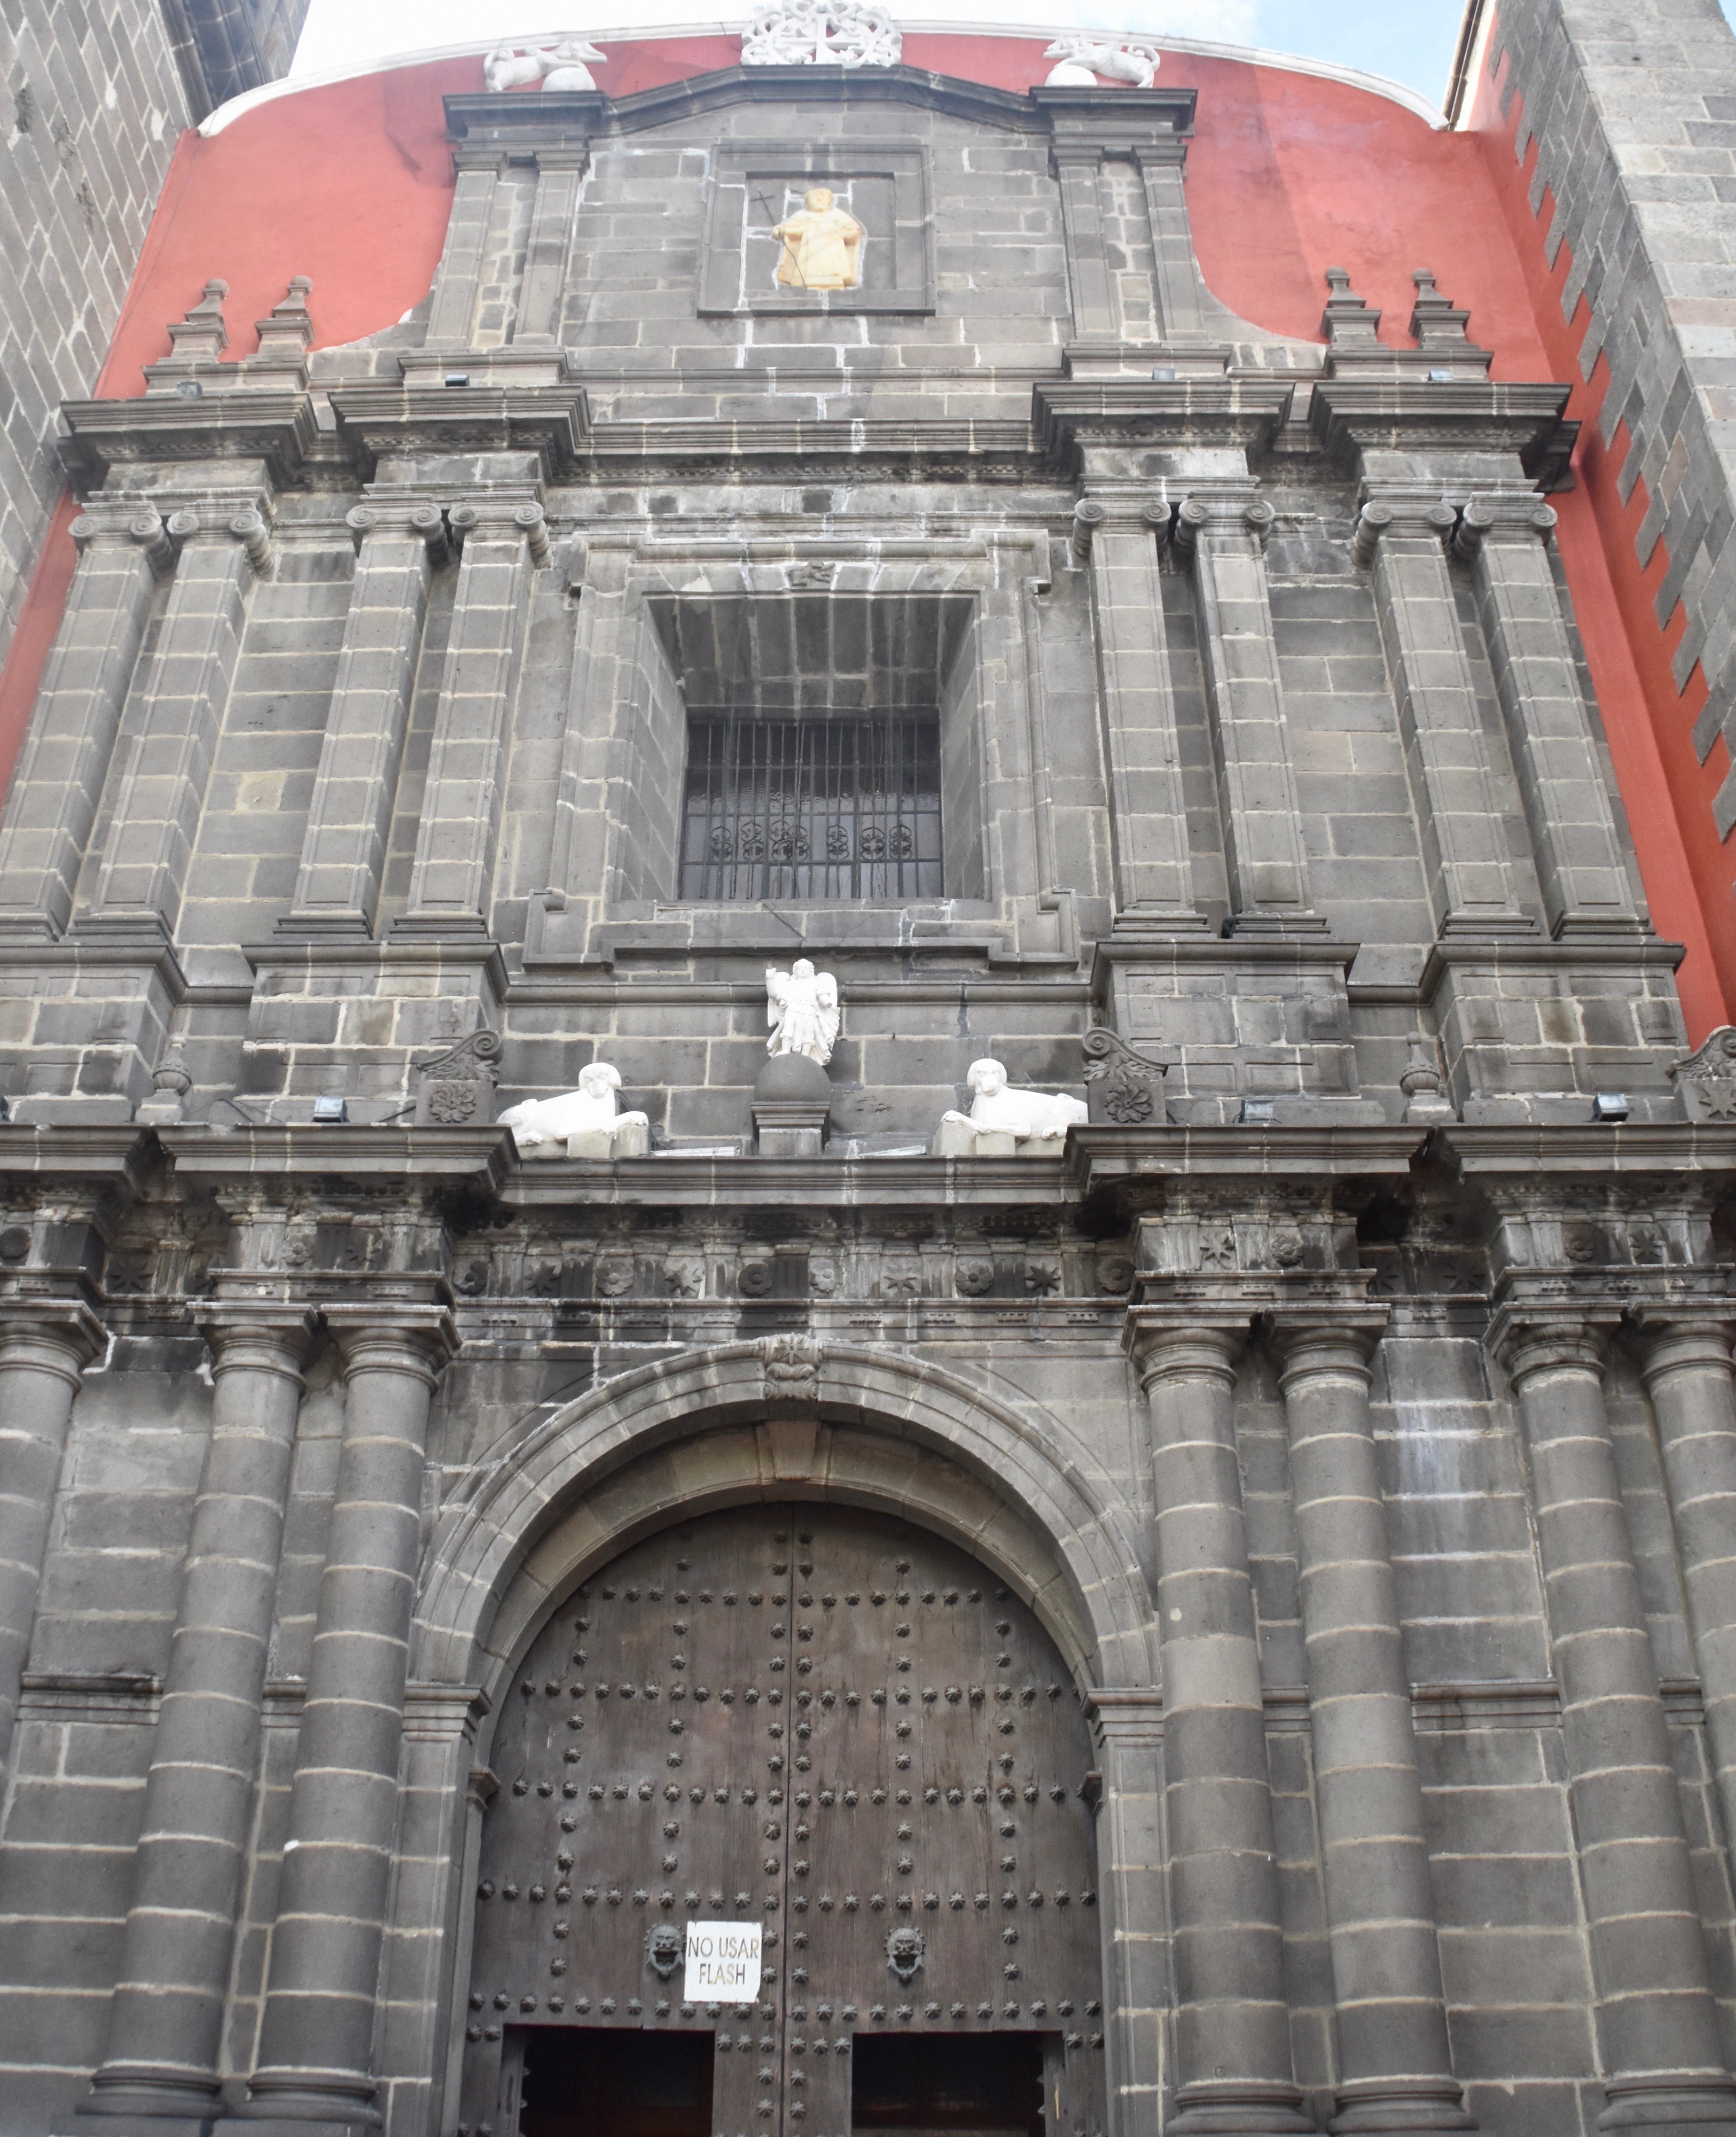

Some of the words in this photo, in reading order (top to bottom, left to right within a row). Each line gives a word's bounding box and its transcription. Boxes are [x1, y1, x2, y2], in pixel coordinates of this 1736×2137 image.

[688, 1937, 713, 1957] NO
[719, 1937, 759, 1959] USAR
[699, 1963, 745, 1985] FLASH
